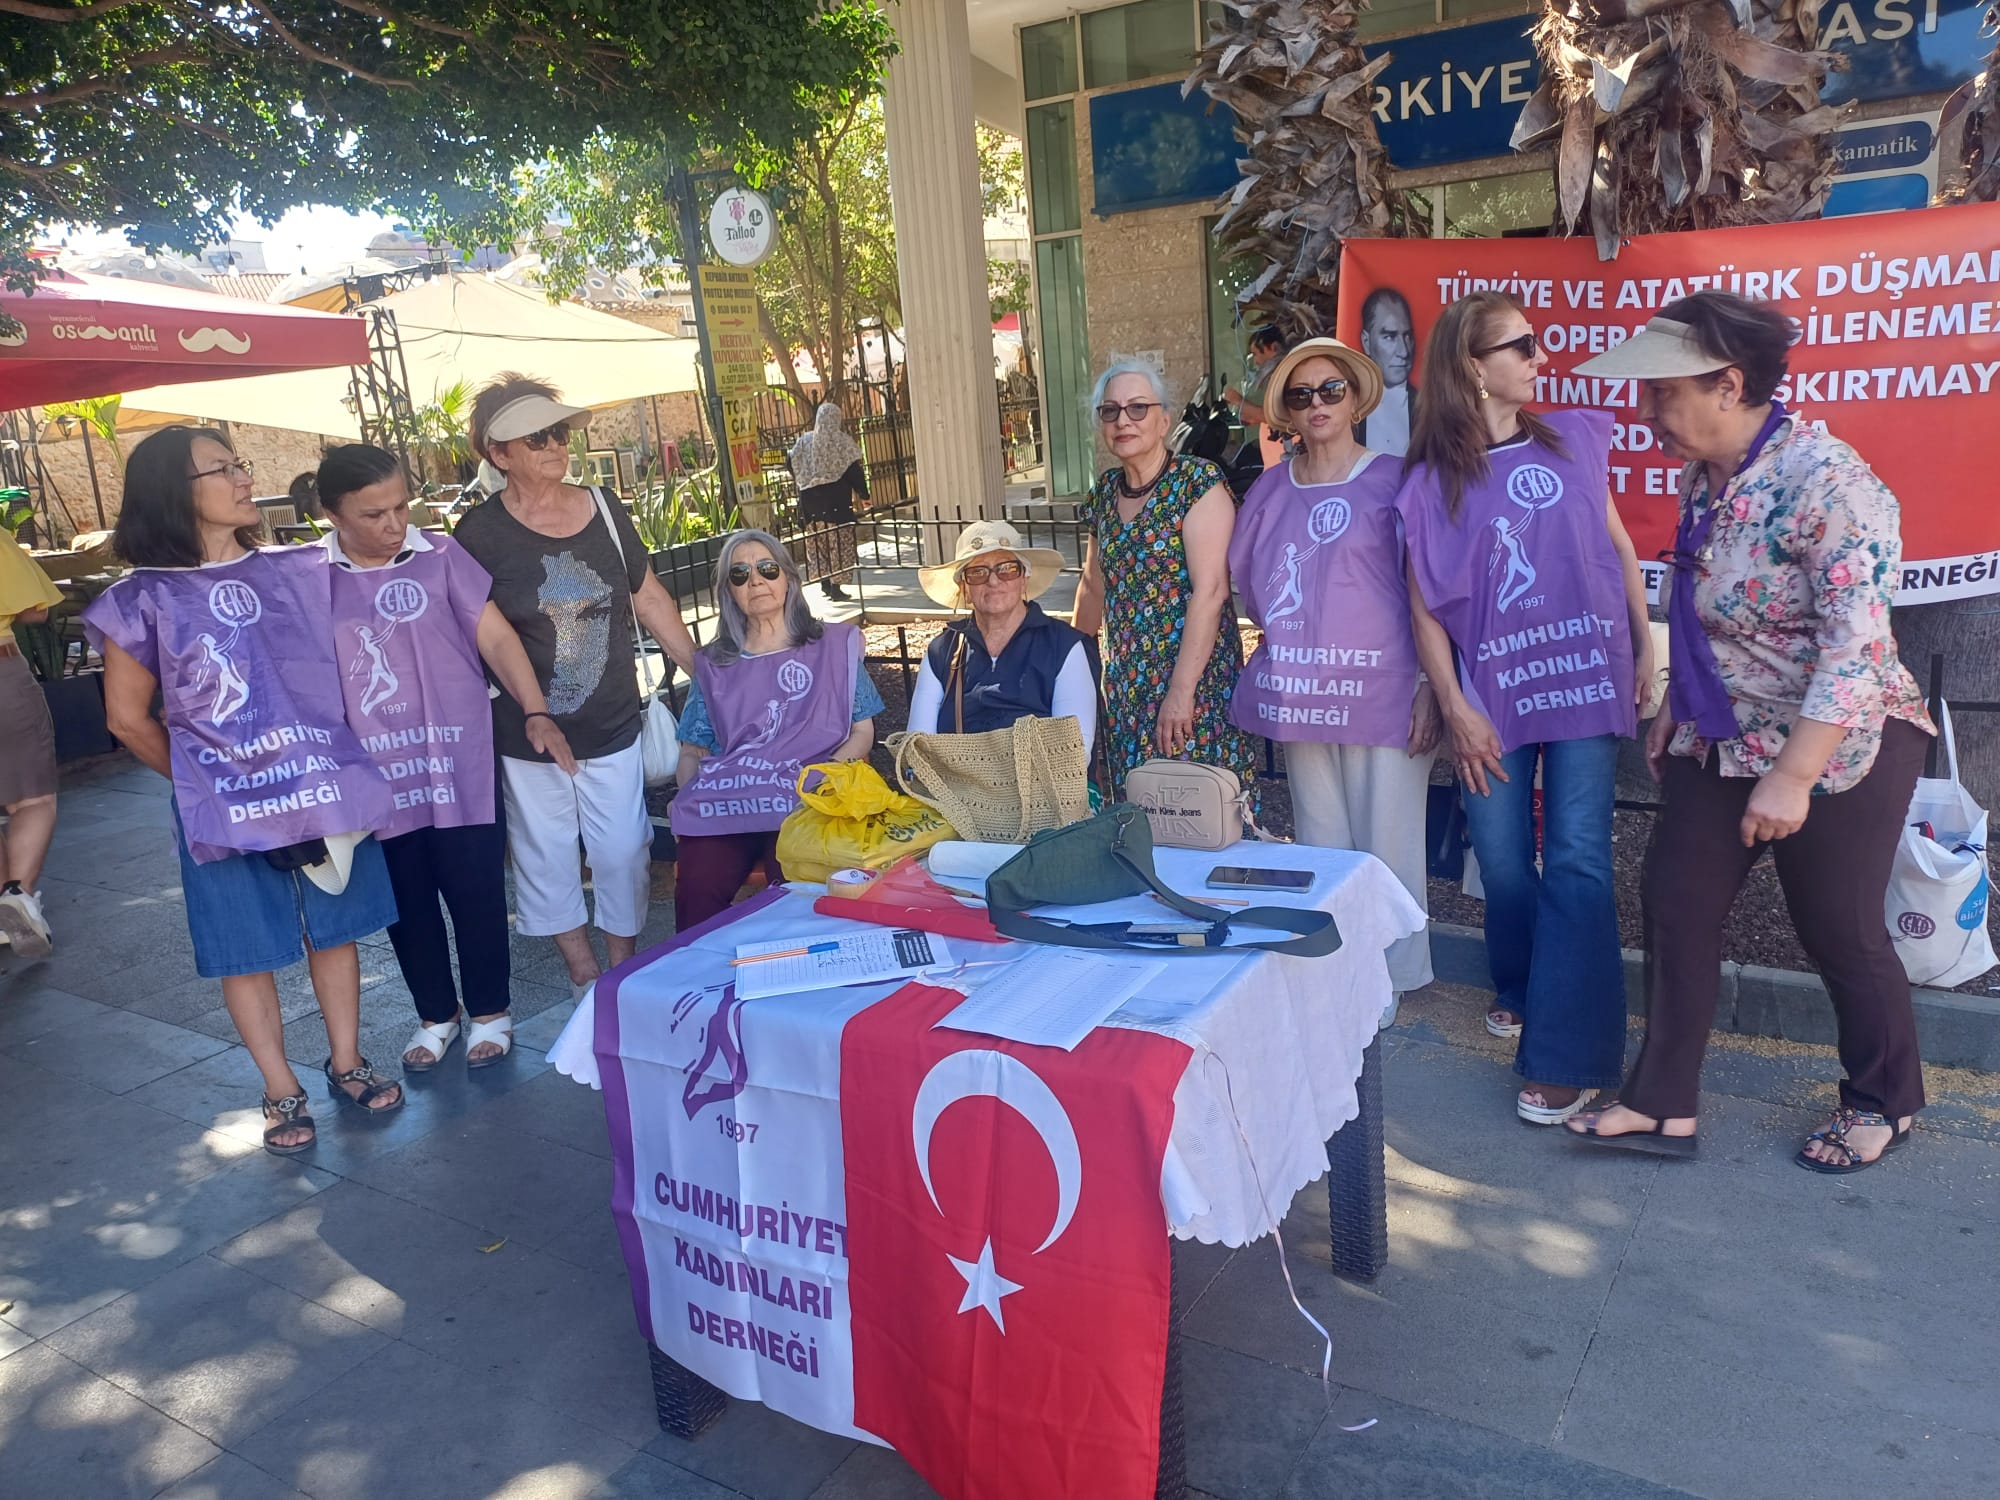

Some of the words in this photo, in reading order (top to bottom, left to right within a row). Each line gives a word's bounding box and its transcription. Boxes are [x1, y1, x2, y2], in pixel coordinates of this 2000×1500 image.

[1819, 0, 1938, 51] ASI
[1563, 280, 1605, 309] VE
[731, 441, 760, 478] WC
[1896, 553, 2000, 591] RNEĞİ
[1517, 594, 1546, 612] 1997
[1281, 620, 1304, 631] 1997
[1255, 671, 1364, 697] KADINLARI
[1496, 648, 1609, 690] KADINLA
[233, 708, 259, 725] 1997
[381, 703, 408, 716] 1997
[1258, 702, 1350, 727] DERNEĞİ
[214, 756, 341, 794] KADINLARI
[229, 780, 342, 824] DERNEĞİ
[699, 793, 793, 818] DERNEĞİ
[1159, 806, 1177, 816] Klein
[1179, 807, 1202, 817] Jeans
[715, 1113, 760, 1145] 1997
[654, 1171, 848, 1258] CUMHURİYET
[674, 1235, 833, 1321] KADINLARI
[687, 1300, 820, 1379] DERNEĞİ
